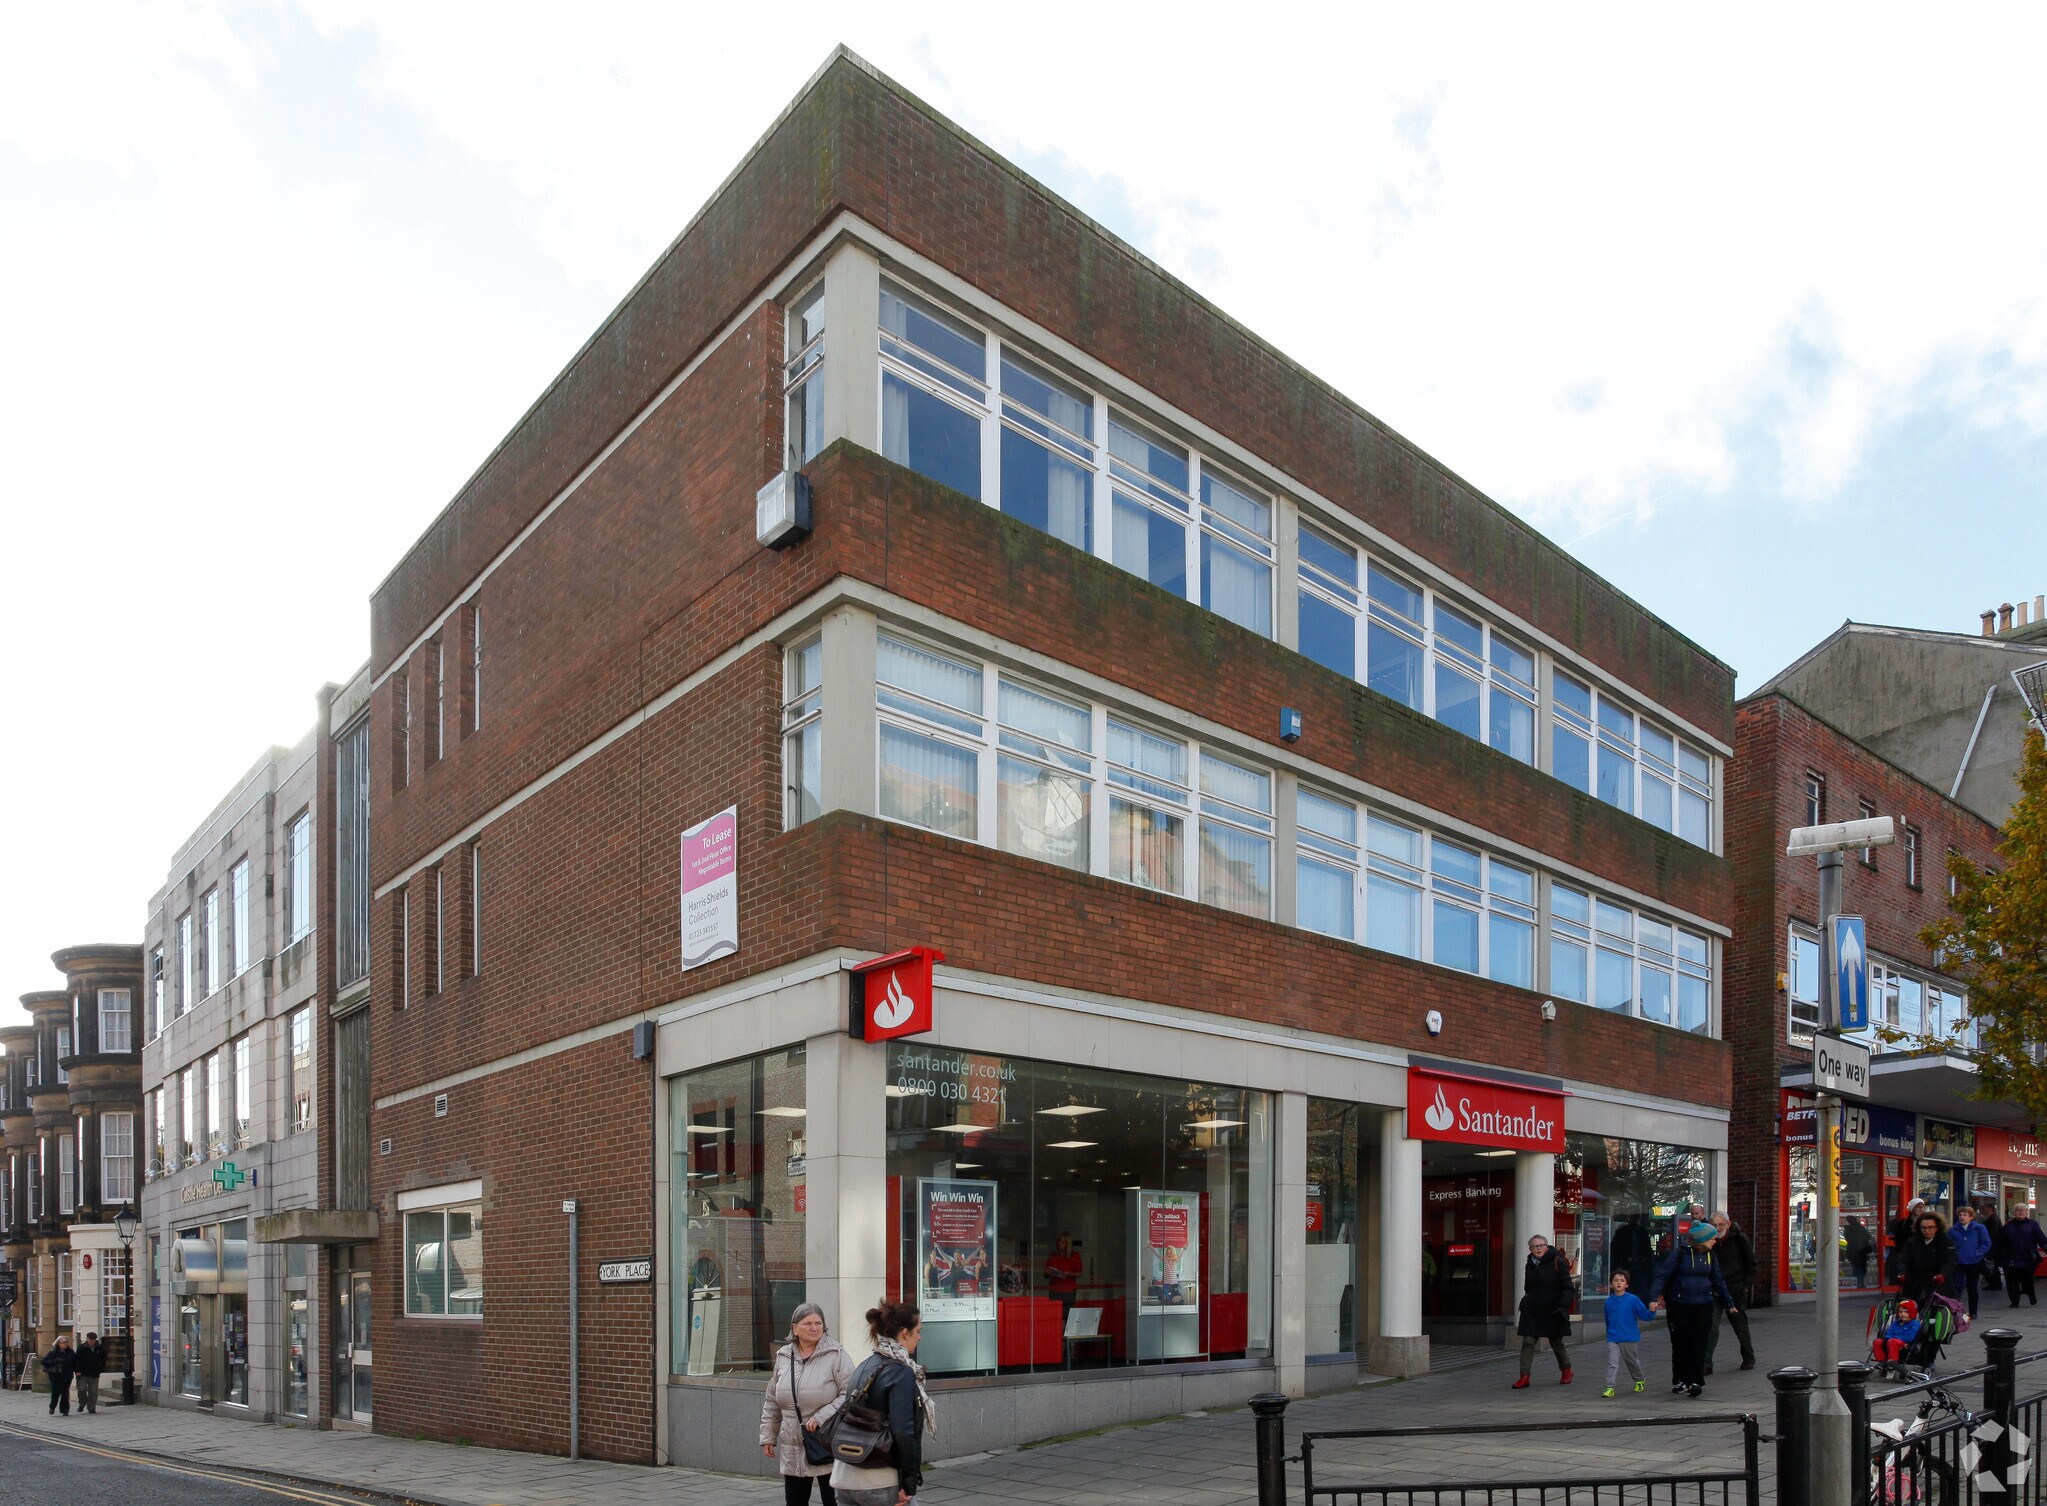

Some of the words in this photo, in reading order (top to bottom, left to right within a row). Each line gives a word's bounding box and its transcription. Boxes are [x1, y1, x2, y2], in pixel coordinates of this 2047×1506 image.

[703, 837, 711, 850] To
[711, 827, 732, 845] Lease
[720, 845, 732, 855] Office
[719, 855, 732, 865] Terms
[688, 896, 706, 912] Harris
[706, 886, 729, 905] Shields
[688, 906, 719, 926] Collection
[688, 928, 702, 941] 01723
[897, 1053, 1017, 1082] santander.co.uk
[1819, 1049, 1841, 1077] One
[1845, 1062, 1866, 1088] way
[898, 1076, 936, 1097] 0800
[940, 1081, 968, 1101] 030
[971, 1085, 1005, 1105] 4321
[1458, 1097, 1555, 1141] Santander
[1785, 1133, 1814, 1142] bonus
[1879, 1132, 1899, 1149] bonus
[1900, 1137, 1914, 1153] king
[930, 1191, 948, 1202] Win
[949, 1192, 966, 1203] Win
[967, 1193, 984, 1203] Win
[1429, 1190, 1462, 1202] Express
[1465, 1186, 1502, 1198] Bankng
[1172, 1202, 1189, 1211] please
[602, 1265, 621, 1278] YORK
[625, 1263, 649, 1277] PLACE
